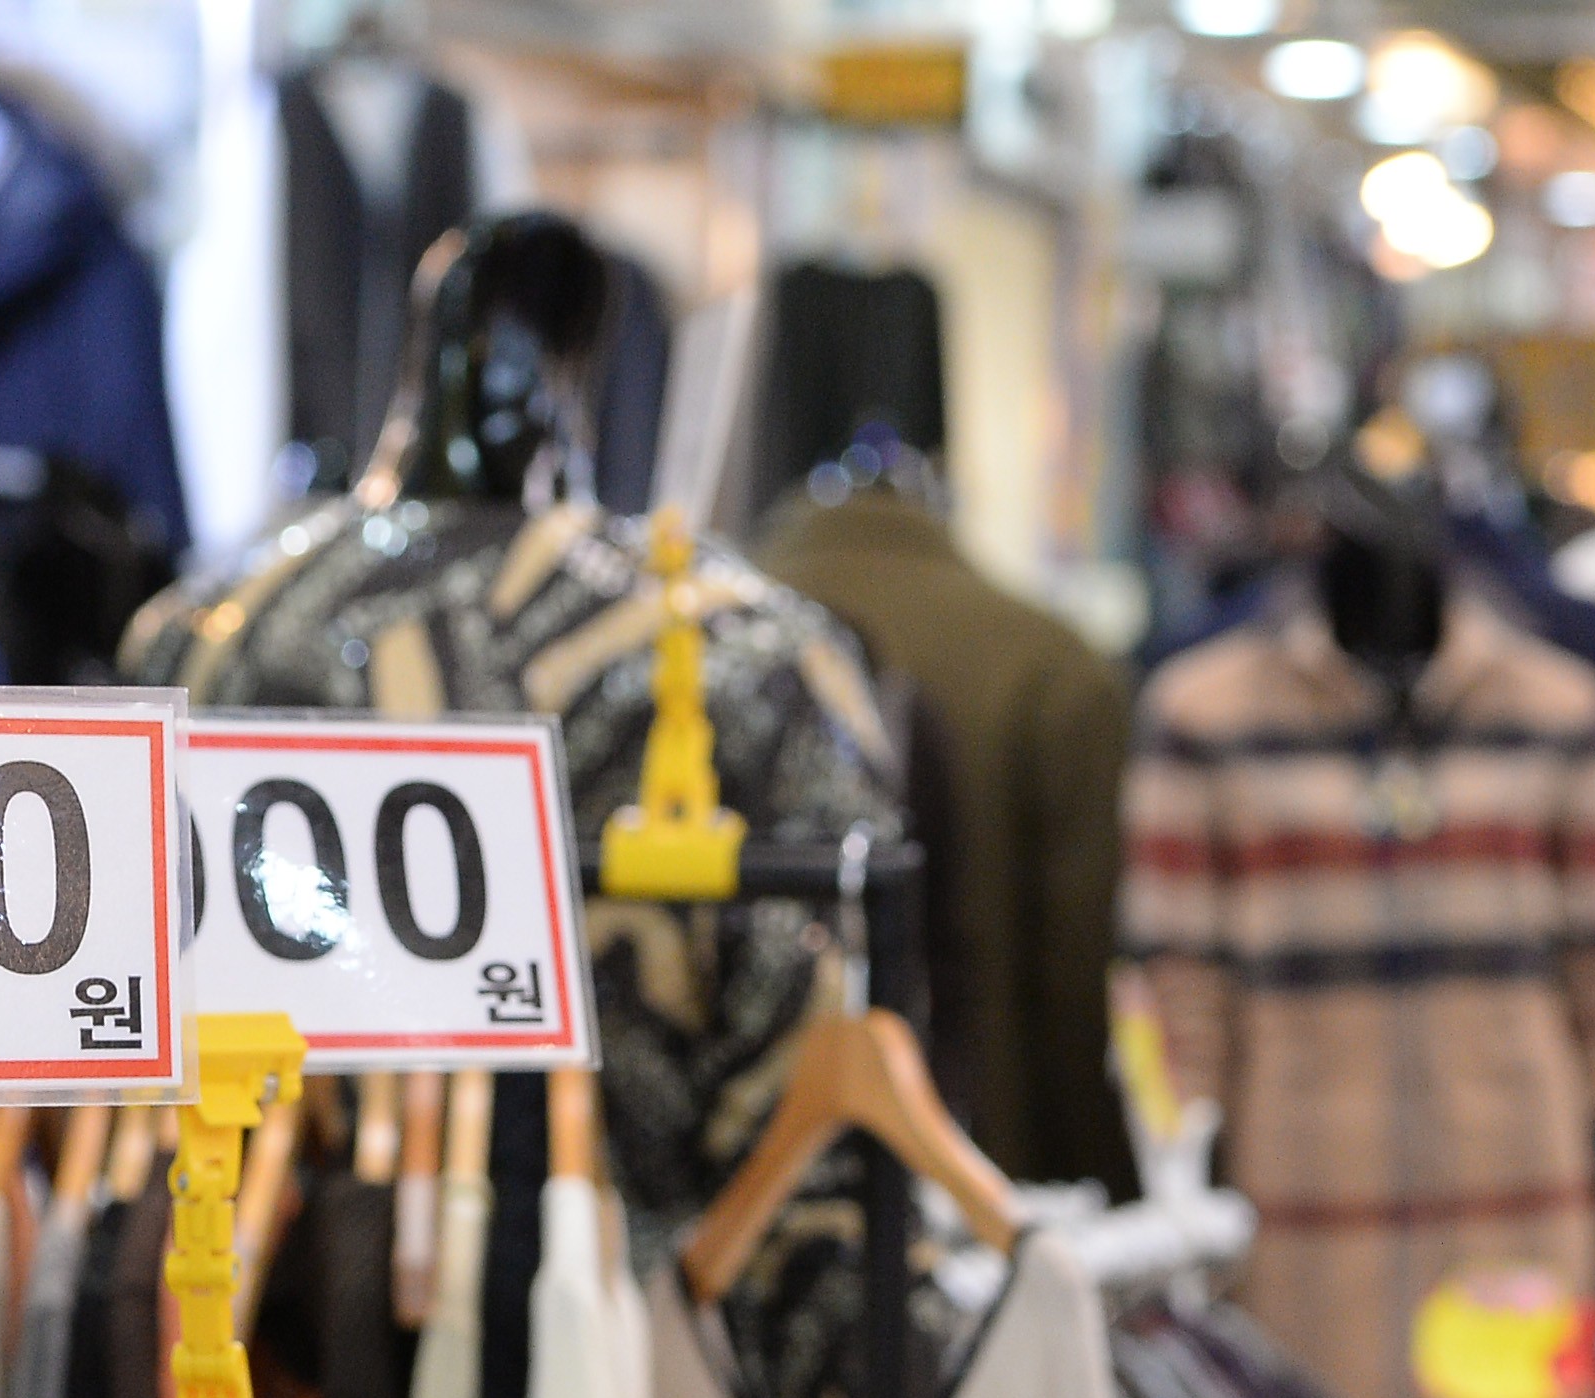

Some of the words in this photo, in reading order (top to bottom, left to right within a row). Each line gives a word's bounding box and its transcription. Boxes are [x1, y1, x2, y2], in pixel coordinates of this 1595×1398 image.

[178, 778, 489, 963] 00
[477, 961, 544, 1024] 원
[68, 975, 144, 1051] 원
